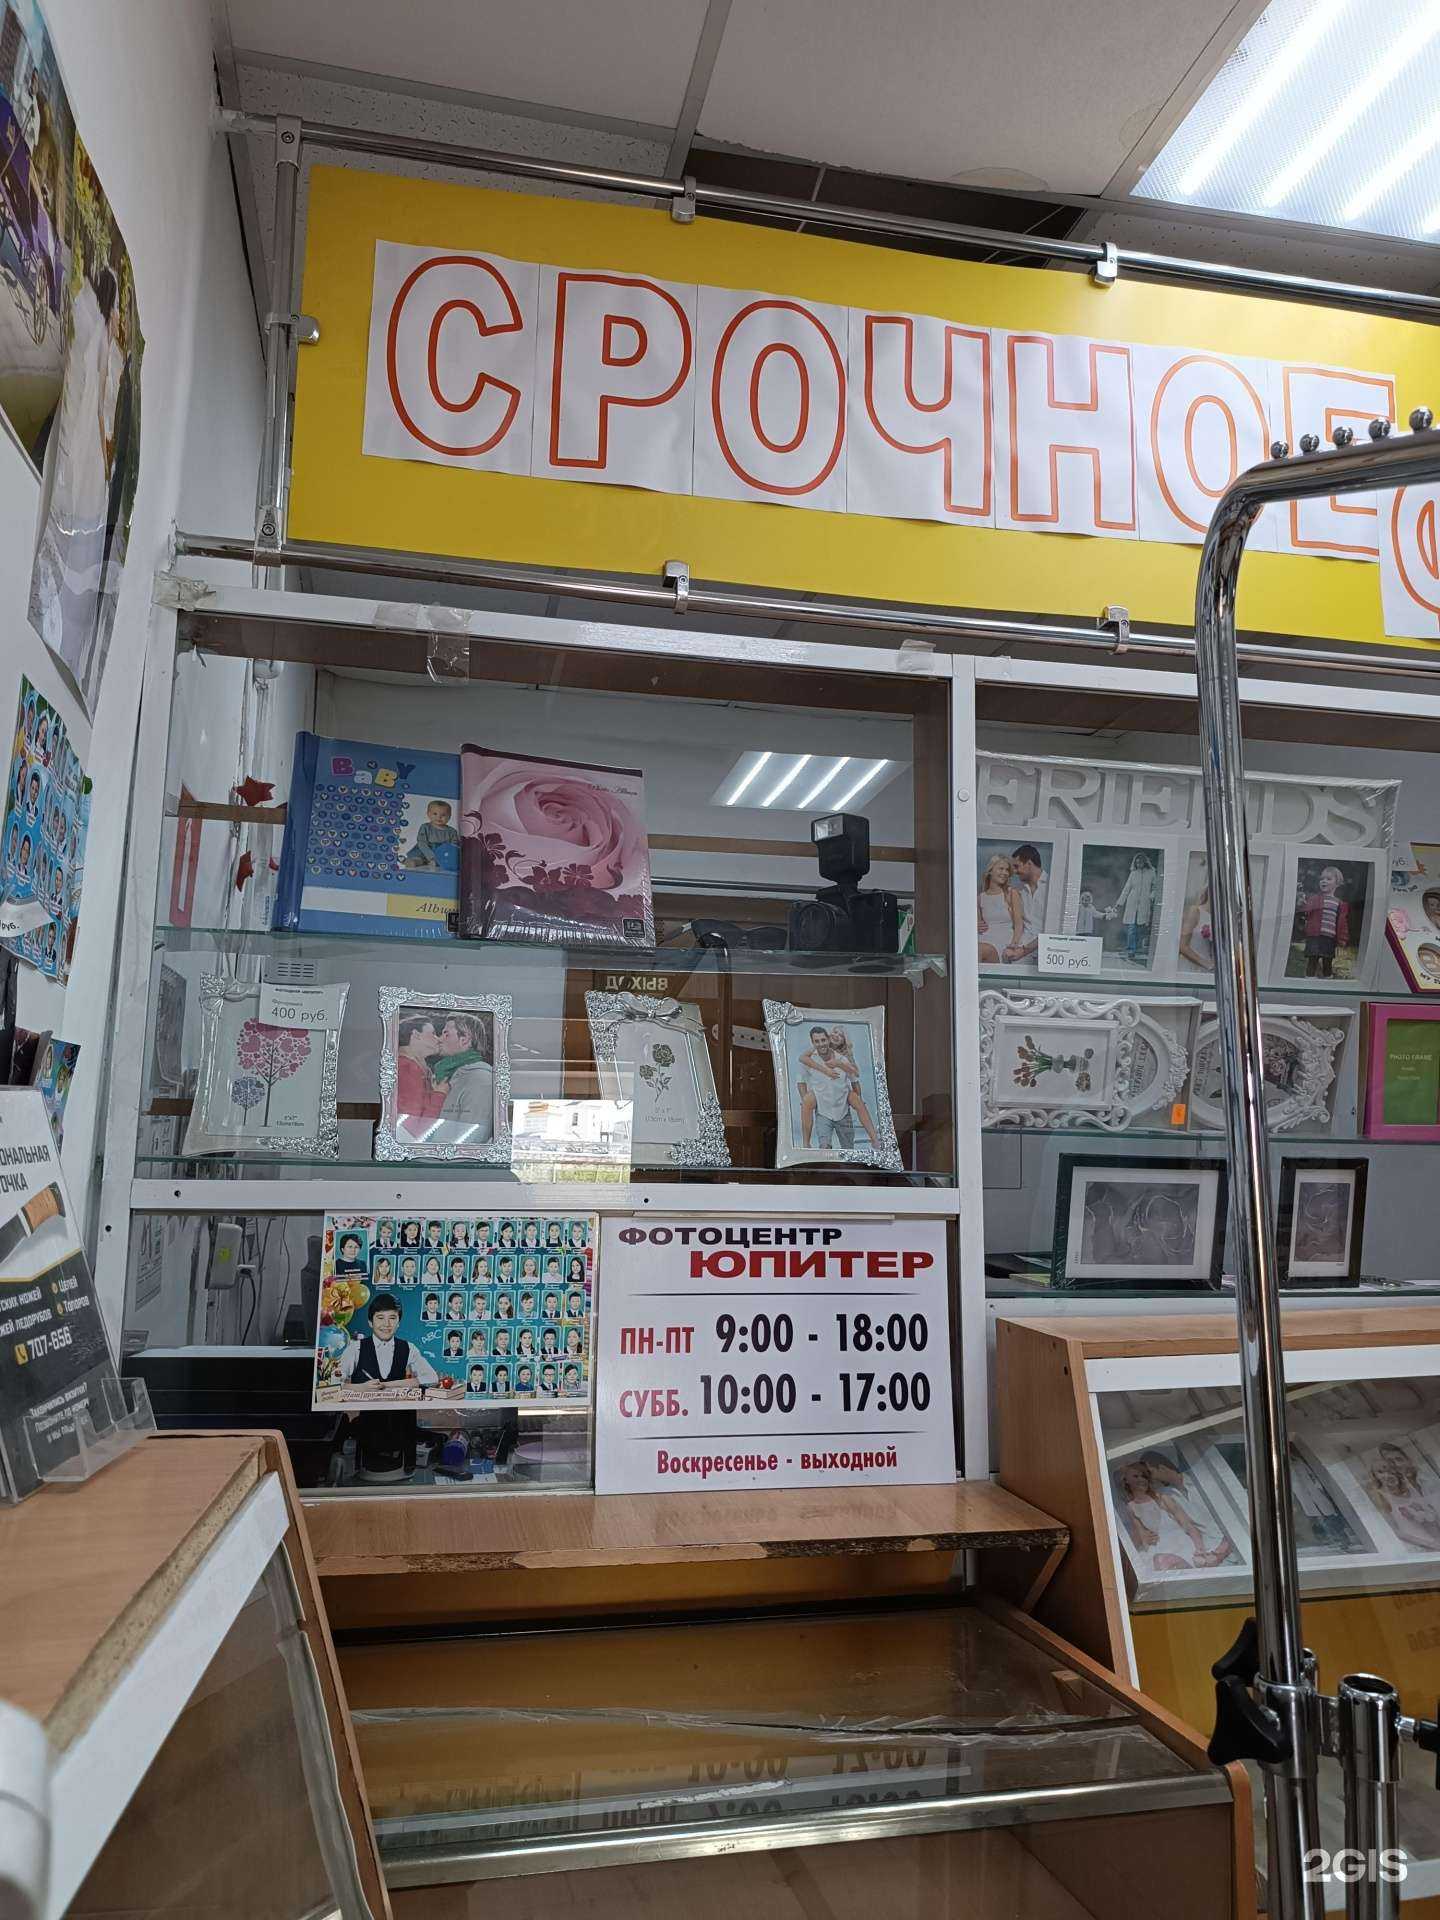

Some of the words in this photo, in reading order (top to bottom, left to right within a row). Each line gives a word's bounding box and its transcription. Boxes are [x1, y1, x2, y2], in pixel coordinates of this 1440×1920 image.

[386, 254, 1396, 558] СРОЧНОЕ
[1046, 953, 1065, 966] 500
[1068, 956, 1092, 969] руб.
[272, 1006, 296, 1019] 400
[301, 1009, 328, 1023] руб.
[0, 1172, 29, 1193] ОЧКА
[618, 1227, 843, 1248] ФОТОЦЕНТР
[690, 1250, 935, 1279] ЮПИТЕР
[27, 1325, 72, 1360] 707-656
[620, 1326, 696, 1355] ПН-ПТ
[715, 1313, 794, 1353] 9:00
[836, 1313, 929, 1352] 18:00
[618, 1389, 689, 1418] СУББ.
[700, 1373, 797, 1415] 10:00
[839, 1372, 931, 1412] 17:00
[657, 1449, 779, 1480] Воскресенье
[800, 1446, 898, 1471] выходной
